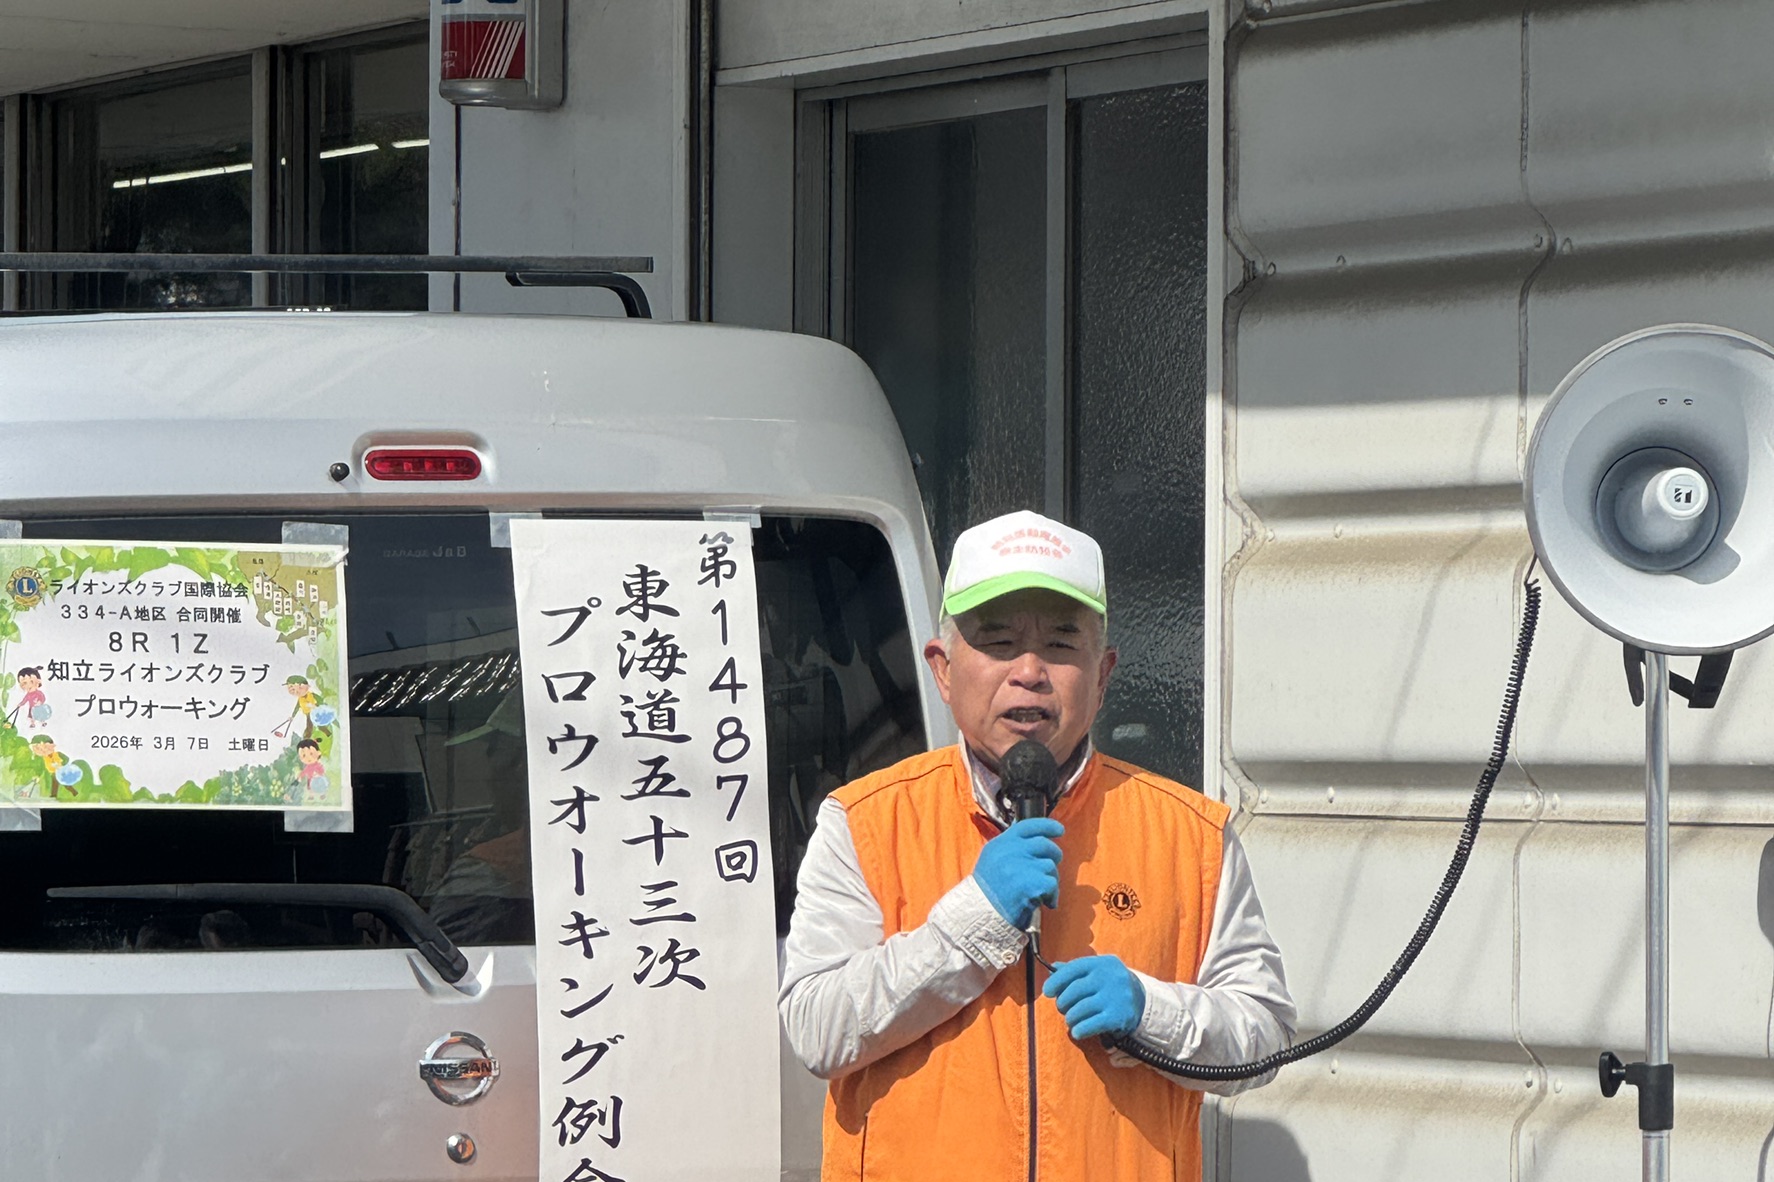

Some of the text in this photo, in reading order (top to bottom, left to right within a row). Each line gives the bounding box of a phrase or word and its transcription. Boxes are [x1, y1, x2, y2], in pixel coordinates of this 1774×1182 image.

[51, 579, 251, 599] ライオンズクラブ国際協会
[61, 604, 242, 624] 334-A地区 合同開催
[48, 659, 270, 684] 知立ライオンズクラブ
[75, 694, 250, 720] プロウォーキング
[698, 531, 759, 883] 第1487回
[91, 736, 269, 751] 2026年 3月 7日 土曜日
[615, 564, 707, 990] 東海道五十三次
